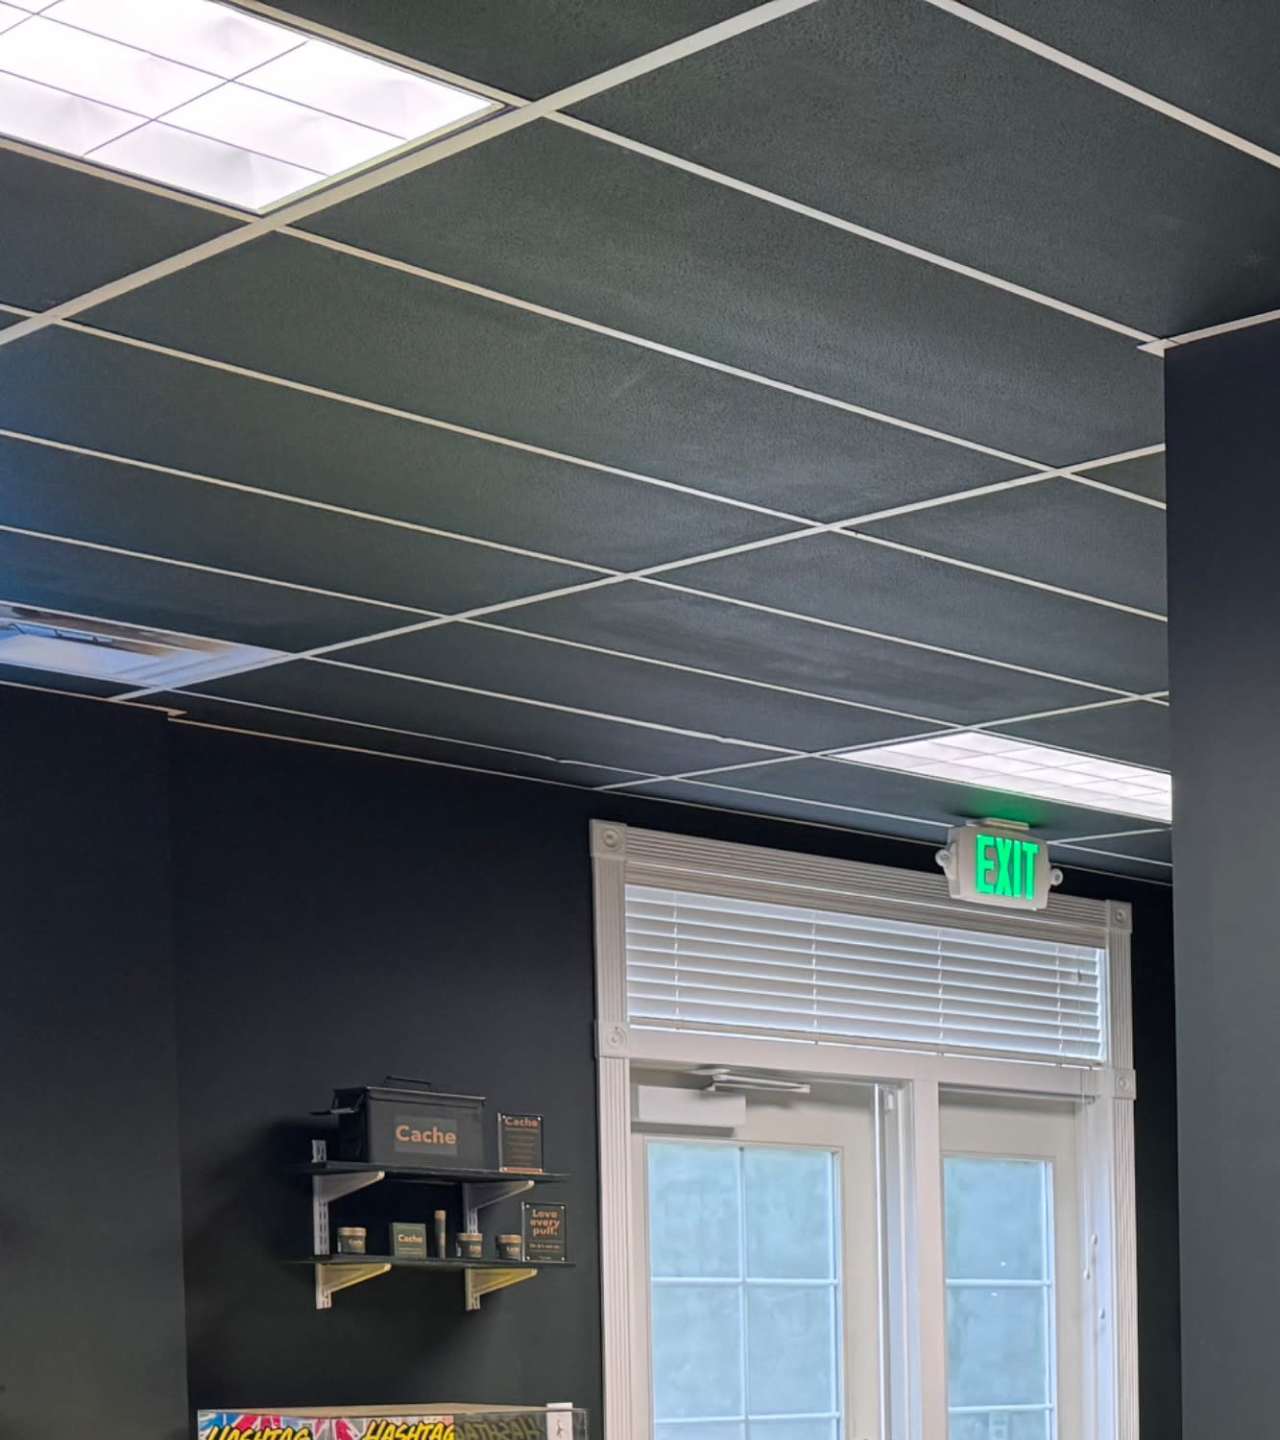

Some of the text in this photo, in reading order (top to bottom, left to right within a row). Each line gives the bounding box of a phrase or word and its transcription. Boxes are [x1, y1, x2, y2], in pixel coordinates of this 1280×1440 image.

[976, 834, 1039, 900] EXIT
[504, 1117, 538, 1128] Cache
[396, 1124, 457, 1145] Cache
